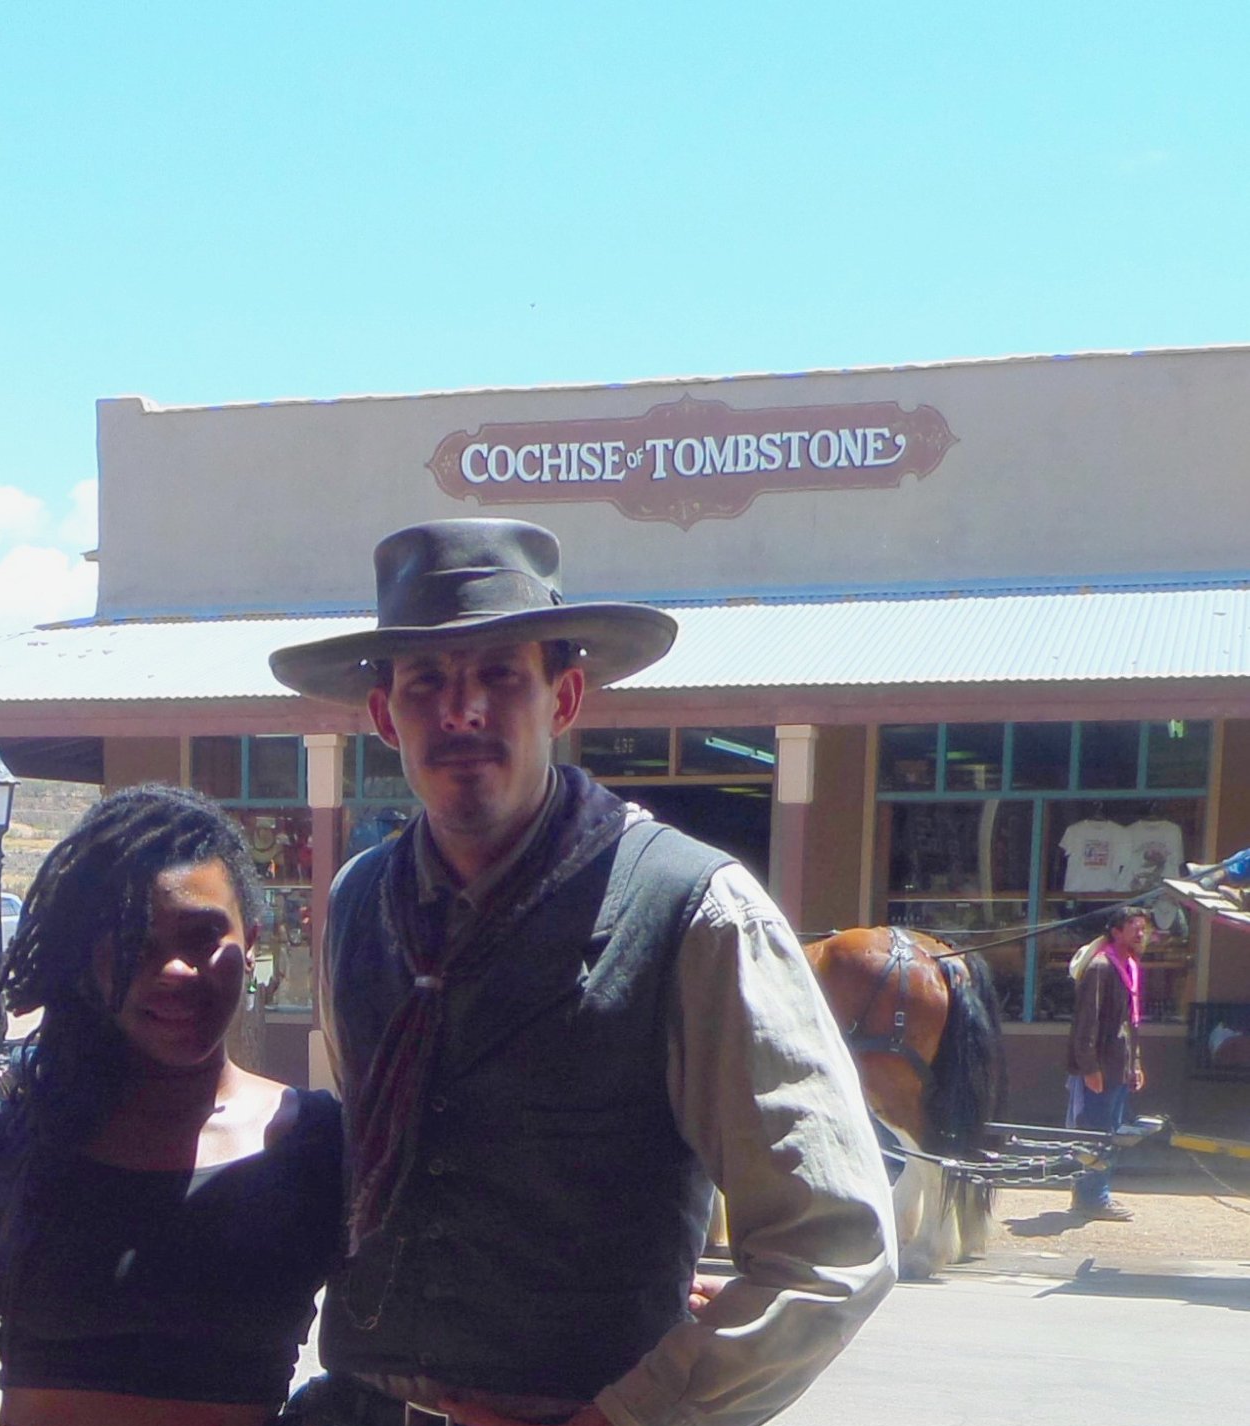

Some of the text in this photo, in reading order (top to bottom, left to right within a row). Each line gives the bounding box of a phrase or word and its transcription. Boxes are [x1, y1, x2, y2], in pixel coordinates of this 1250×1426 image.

[461, 427, 907, 483] COCHISE OF TOMBSTONE
